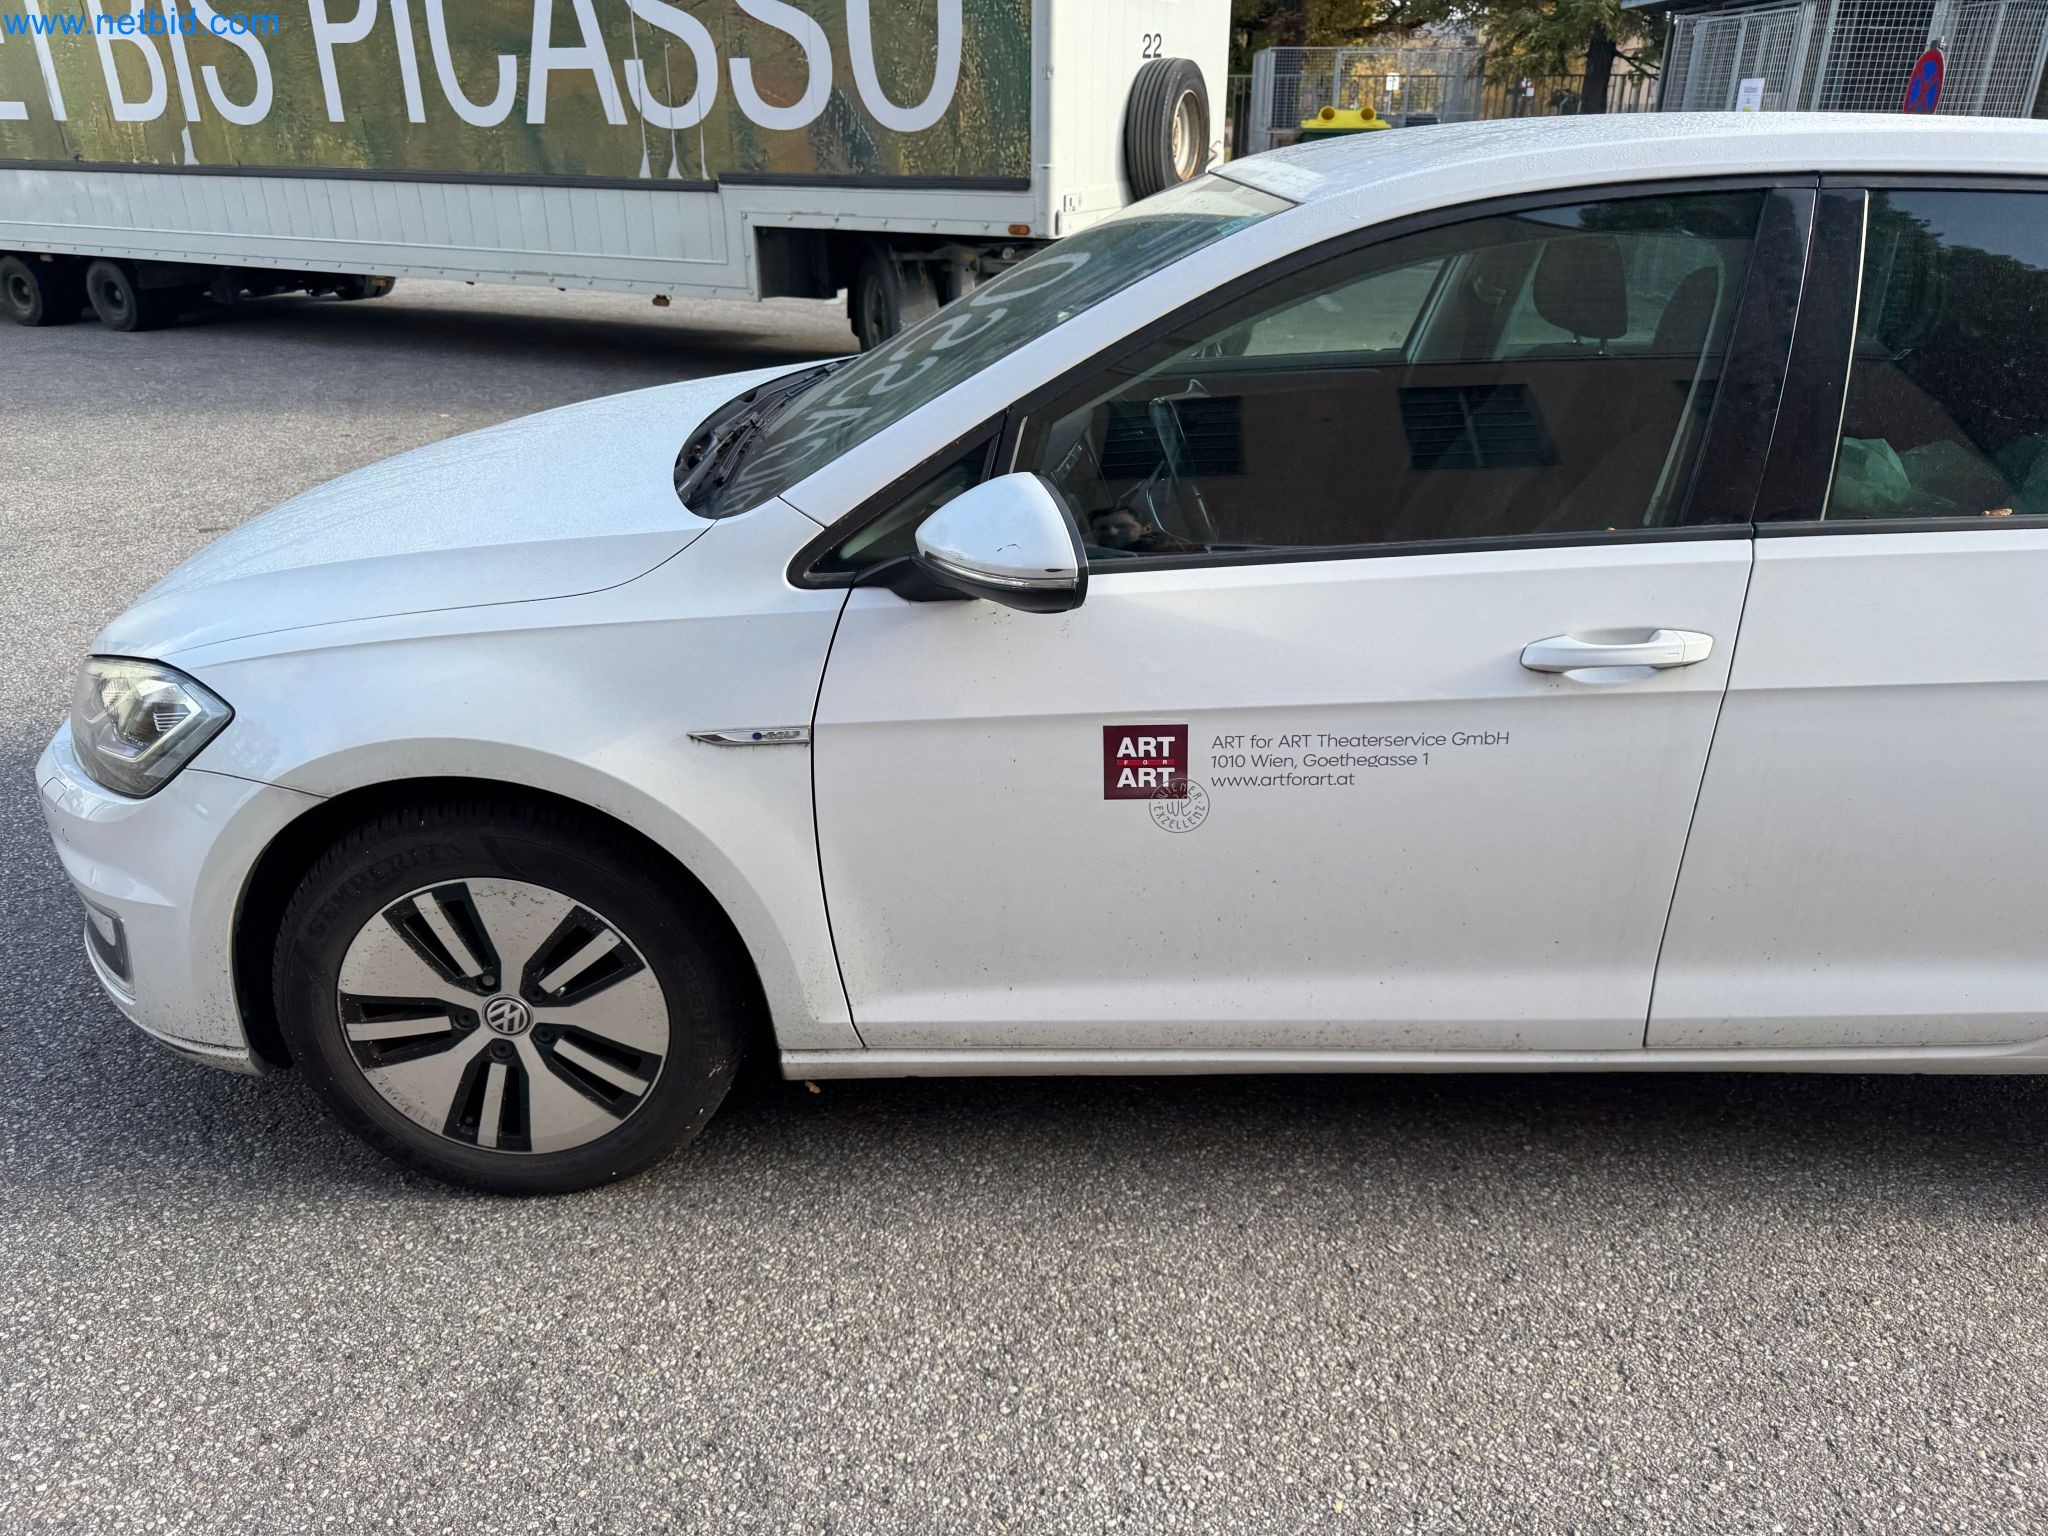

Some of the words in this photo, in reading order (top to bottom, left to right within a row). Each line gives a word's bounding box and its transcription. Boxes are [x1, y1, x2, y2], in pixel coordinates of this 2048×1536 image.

[1142, 33, 1162, 58] 22
[86, 0, 274, 126] BIS
[308, 0, 963, 133] PICASSO
[1116, 736, 1176, 758] ART
[1211, 735, 1245, 750] ART
[1250, 734, 1273, 749] for
[1278, 734, 1312, 748] ART
[1317, 732, 1447, 748] Theaterservice
[1451, 731, 1510, 746] GmbH
[1211, 754, 1246, 769] 1010
[1251, 752, 1298, 770] Wien,
[1303, 752, 1417, 768] Goethegasse
[1422, 752, 1429, 766] 1
[1116, 767, 1176, 788] ART
[1210, 773, 1356, 787] www.artforart.at
[1156, 782, 1203, 801] WIENER
[1154, 805, 1206, 830] EXZELLENZ
